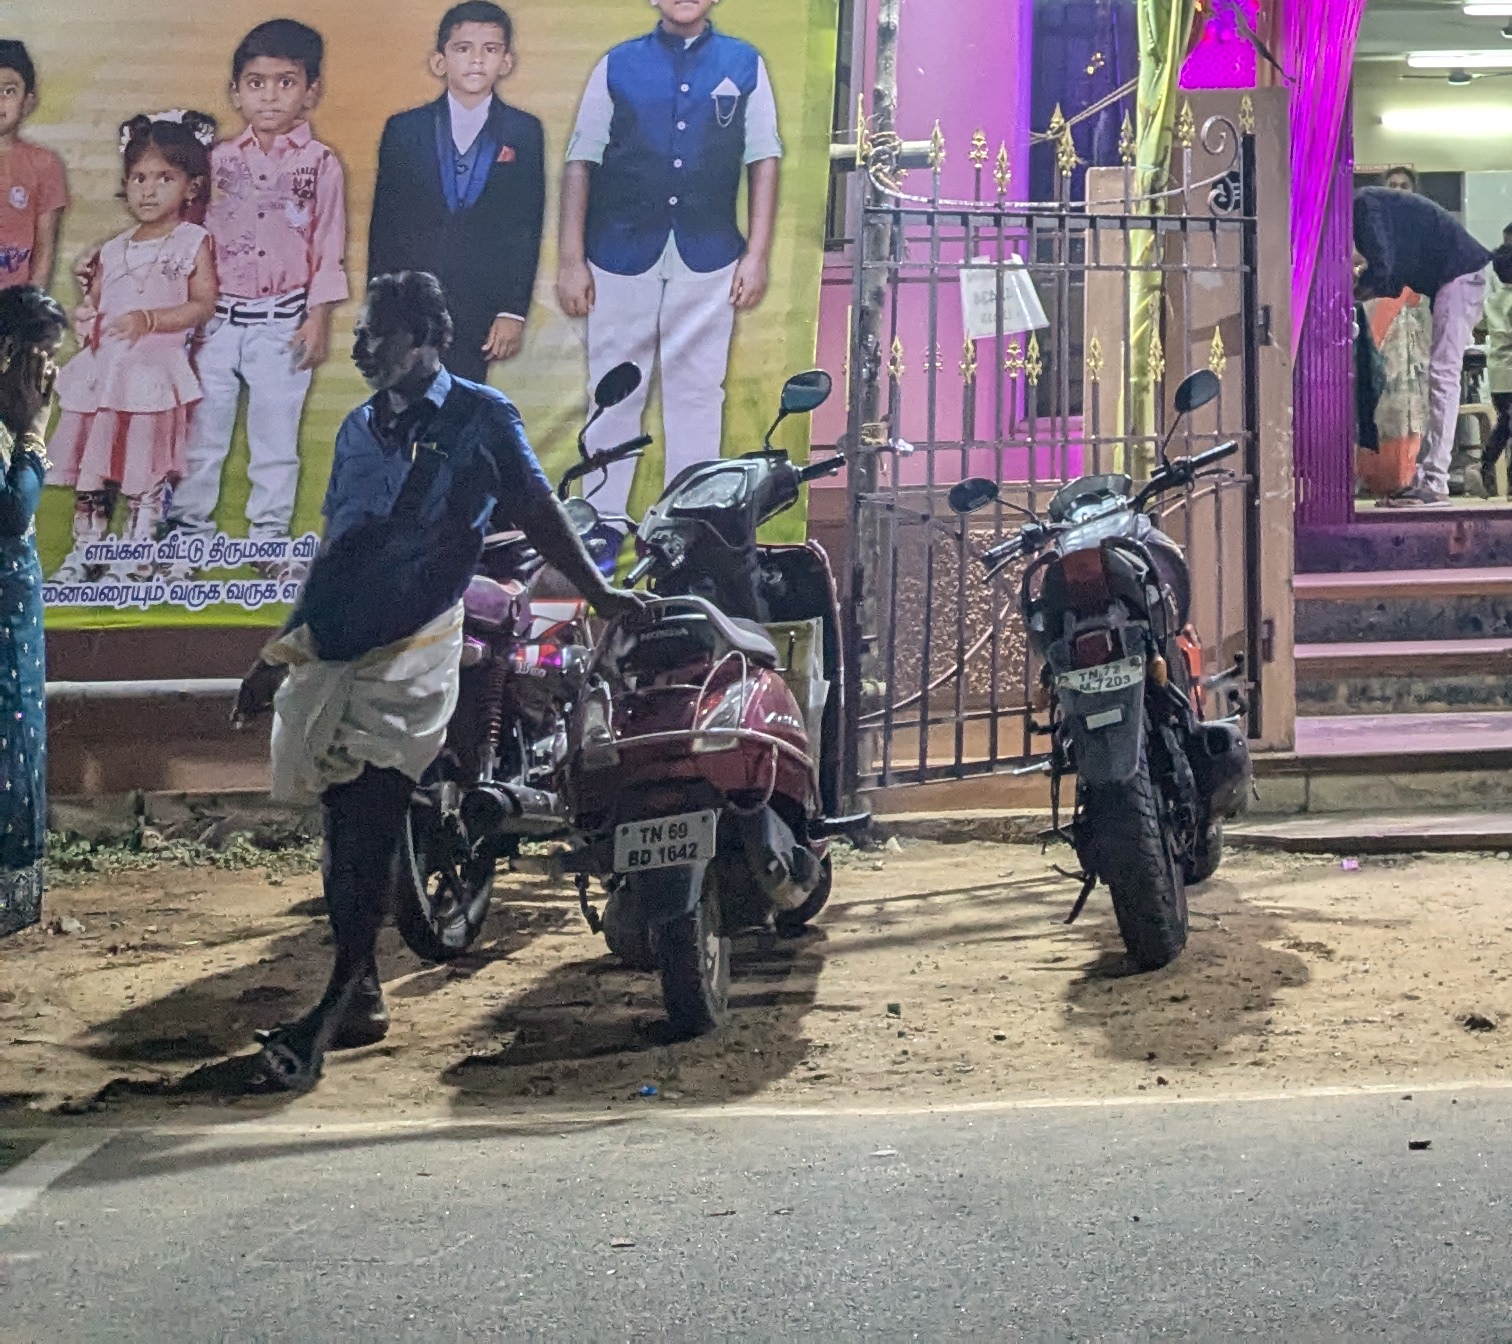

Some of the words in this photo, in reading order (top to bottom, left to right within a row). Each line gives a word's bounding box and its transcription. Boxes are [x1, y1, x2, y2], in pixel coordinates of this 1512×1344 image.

[84, 535, 154, 562] எங்கள்
[157, 532, 205, 564] வீட்டு
[205, 534, 289, 568] திருமண
[42, 576, 165, 607] னைவரையும்
[169, 583, 220, 608] வருக
[226, 583, 278, 607] வருக
[640, 825, 663, 844] TN
[668, 822, 689, 840] 69
[628, 849, 652, 867] BD
[660, 842, 698, 864] 1642
